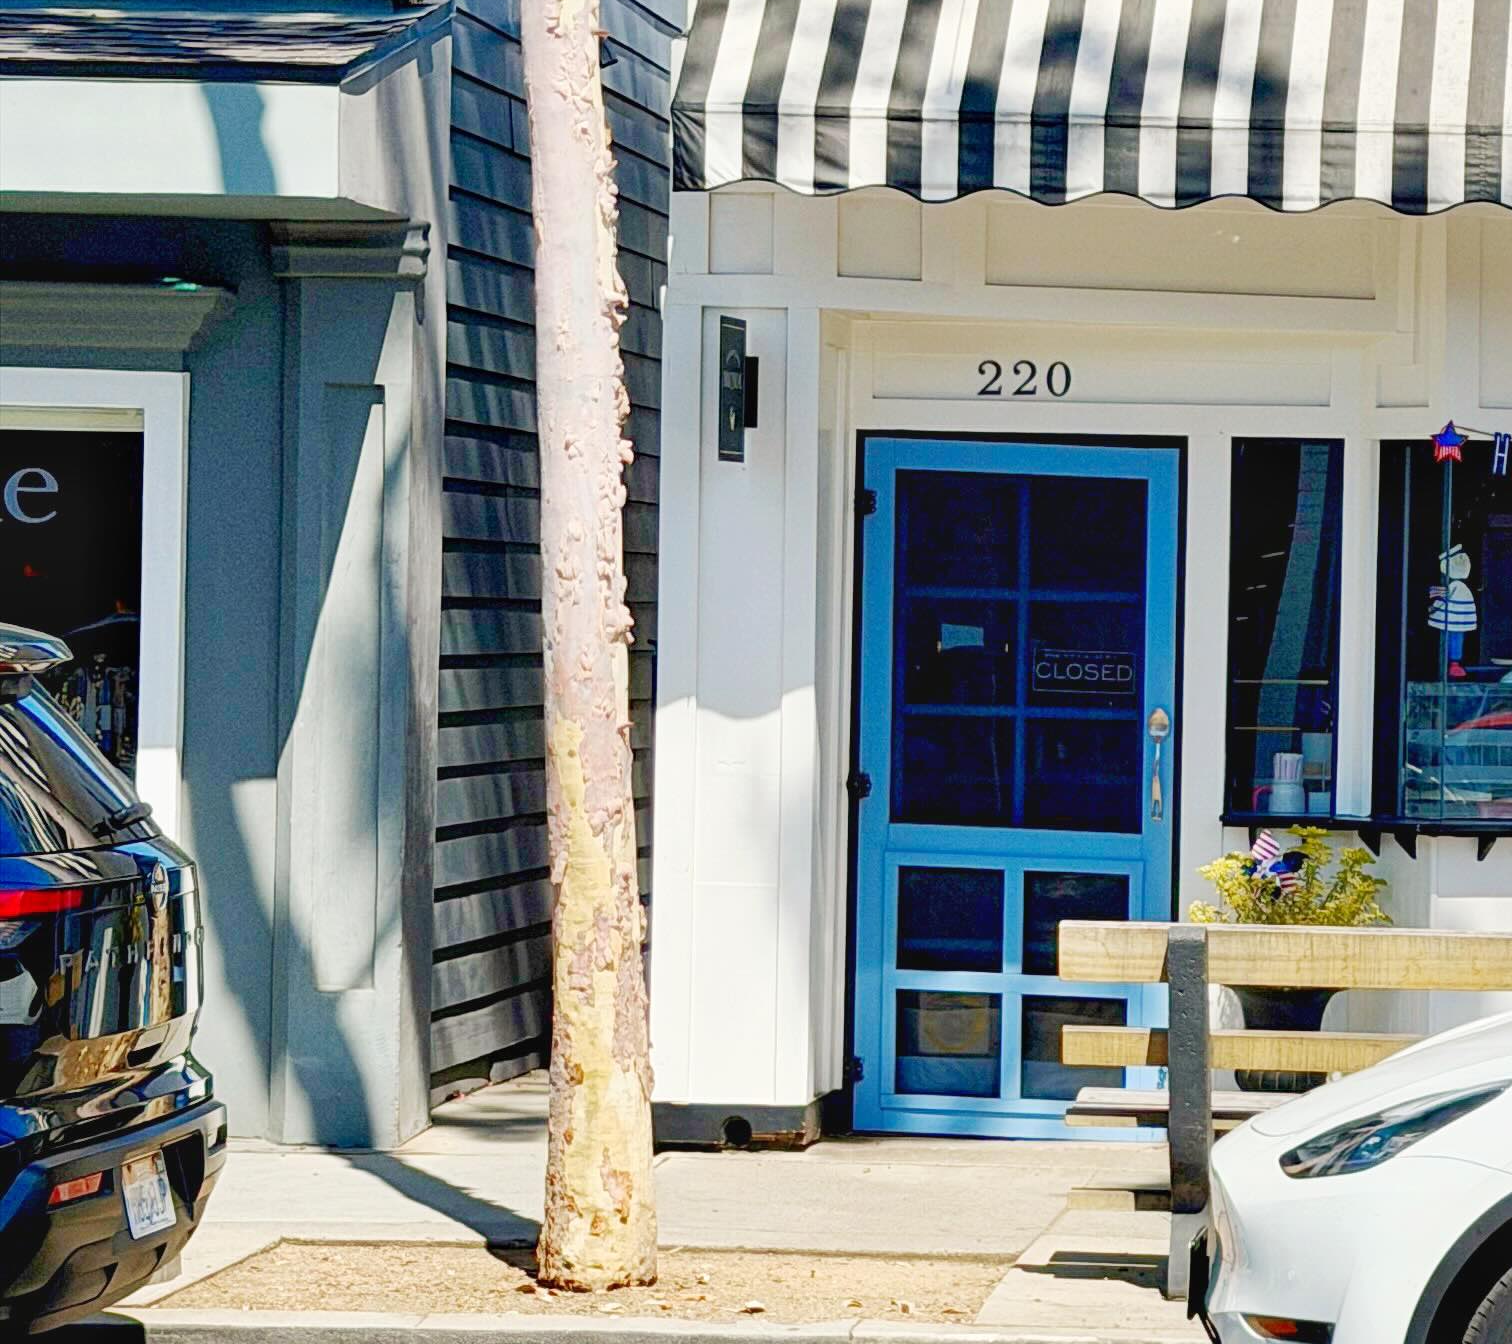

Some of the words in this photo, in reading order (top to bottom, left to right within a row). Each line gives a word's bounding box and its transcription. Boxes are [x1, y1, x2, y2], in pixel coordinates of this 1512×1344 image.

[977, 359, 1072, 397] 220
[0, 467, 59, 524] e
[1036, 661, 1133, 681] CLOSED
